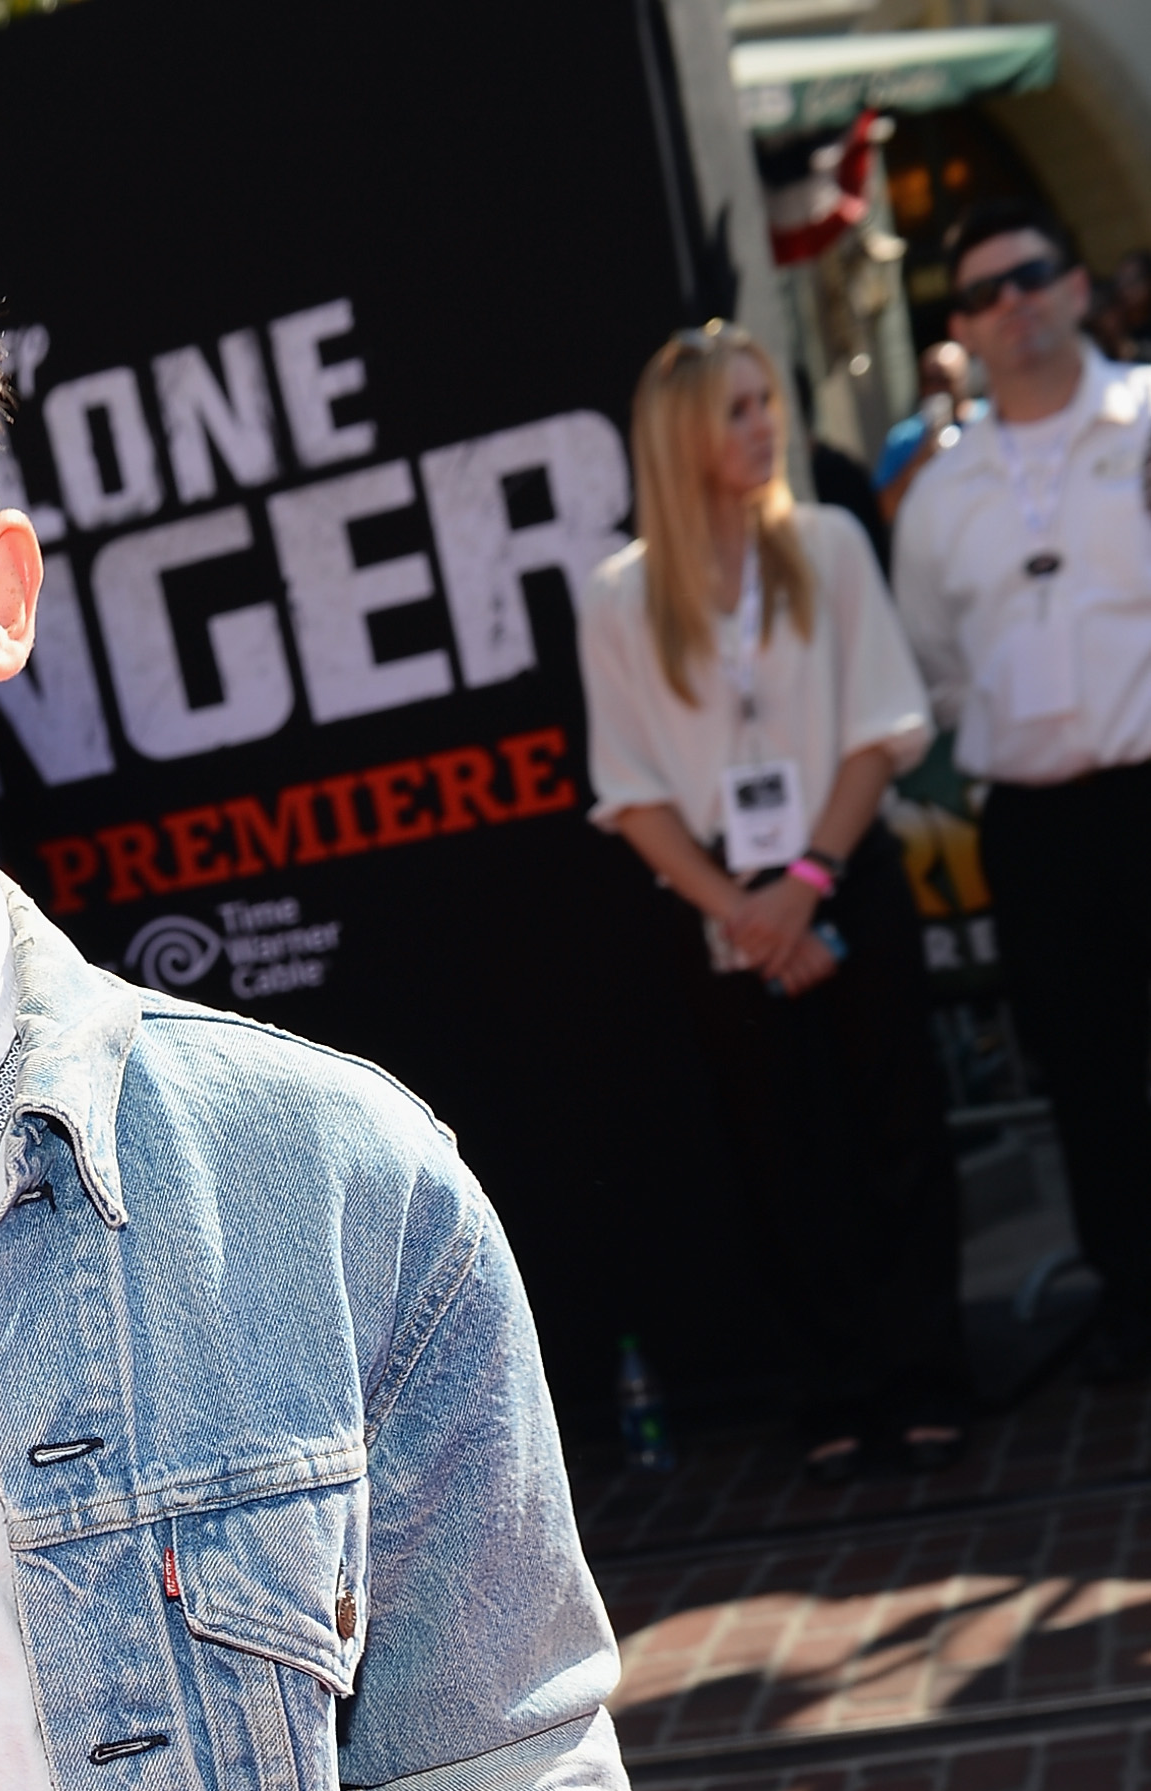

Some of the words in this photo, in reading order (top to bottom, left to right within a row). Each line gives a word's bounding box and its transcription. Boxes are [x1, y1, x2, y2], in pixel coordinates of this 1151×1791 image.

[38, 728, 577, 915] PREMIERE
[216, 896, 300, 932] Time
[224, 921, 342, 966] Warner
[230, 955, 325, 999] Cable
